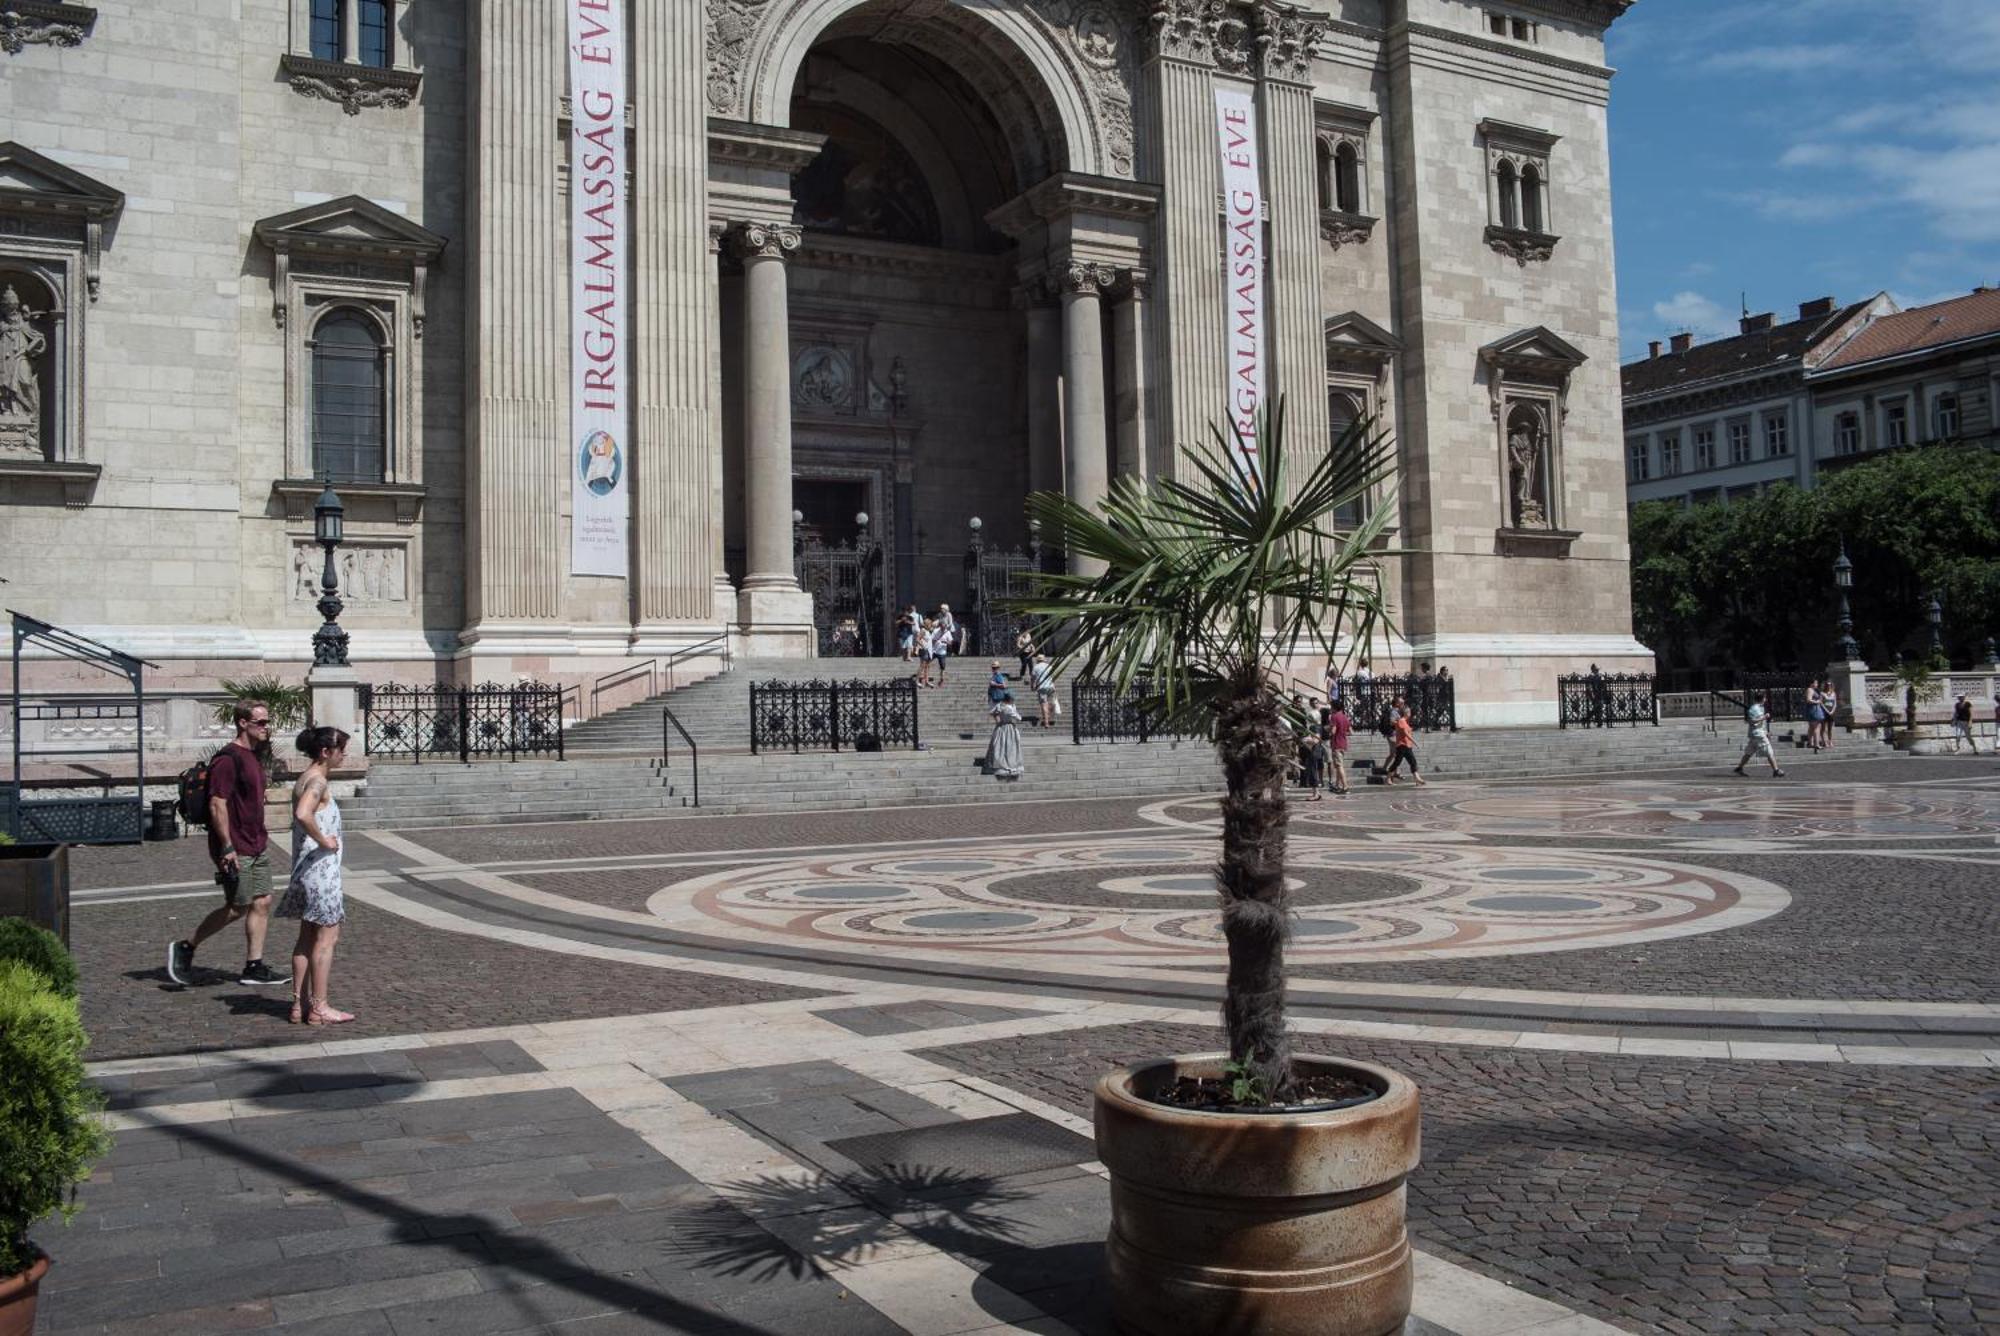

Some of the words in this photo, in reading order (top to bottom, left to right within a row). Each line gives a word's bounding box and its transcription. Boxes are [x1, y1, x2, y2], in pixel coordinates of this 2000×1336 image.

[572, 0, 612, 65] ÉVE
[1223, 107, 1251, 170] ÉVE
[575, 89, 616, 412] IRGALMASSÁG
[1227, 190, 1258, 455] IRGALMASSÁG
